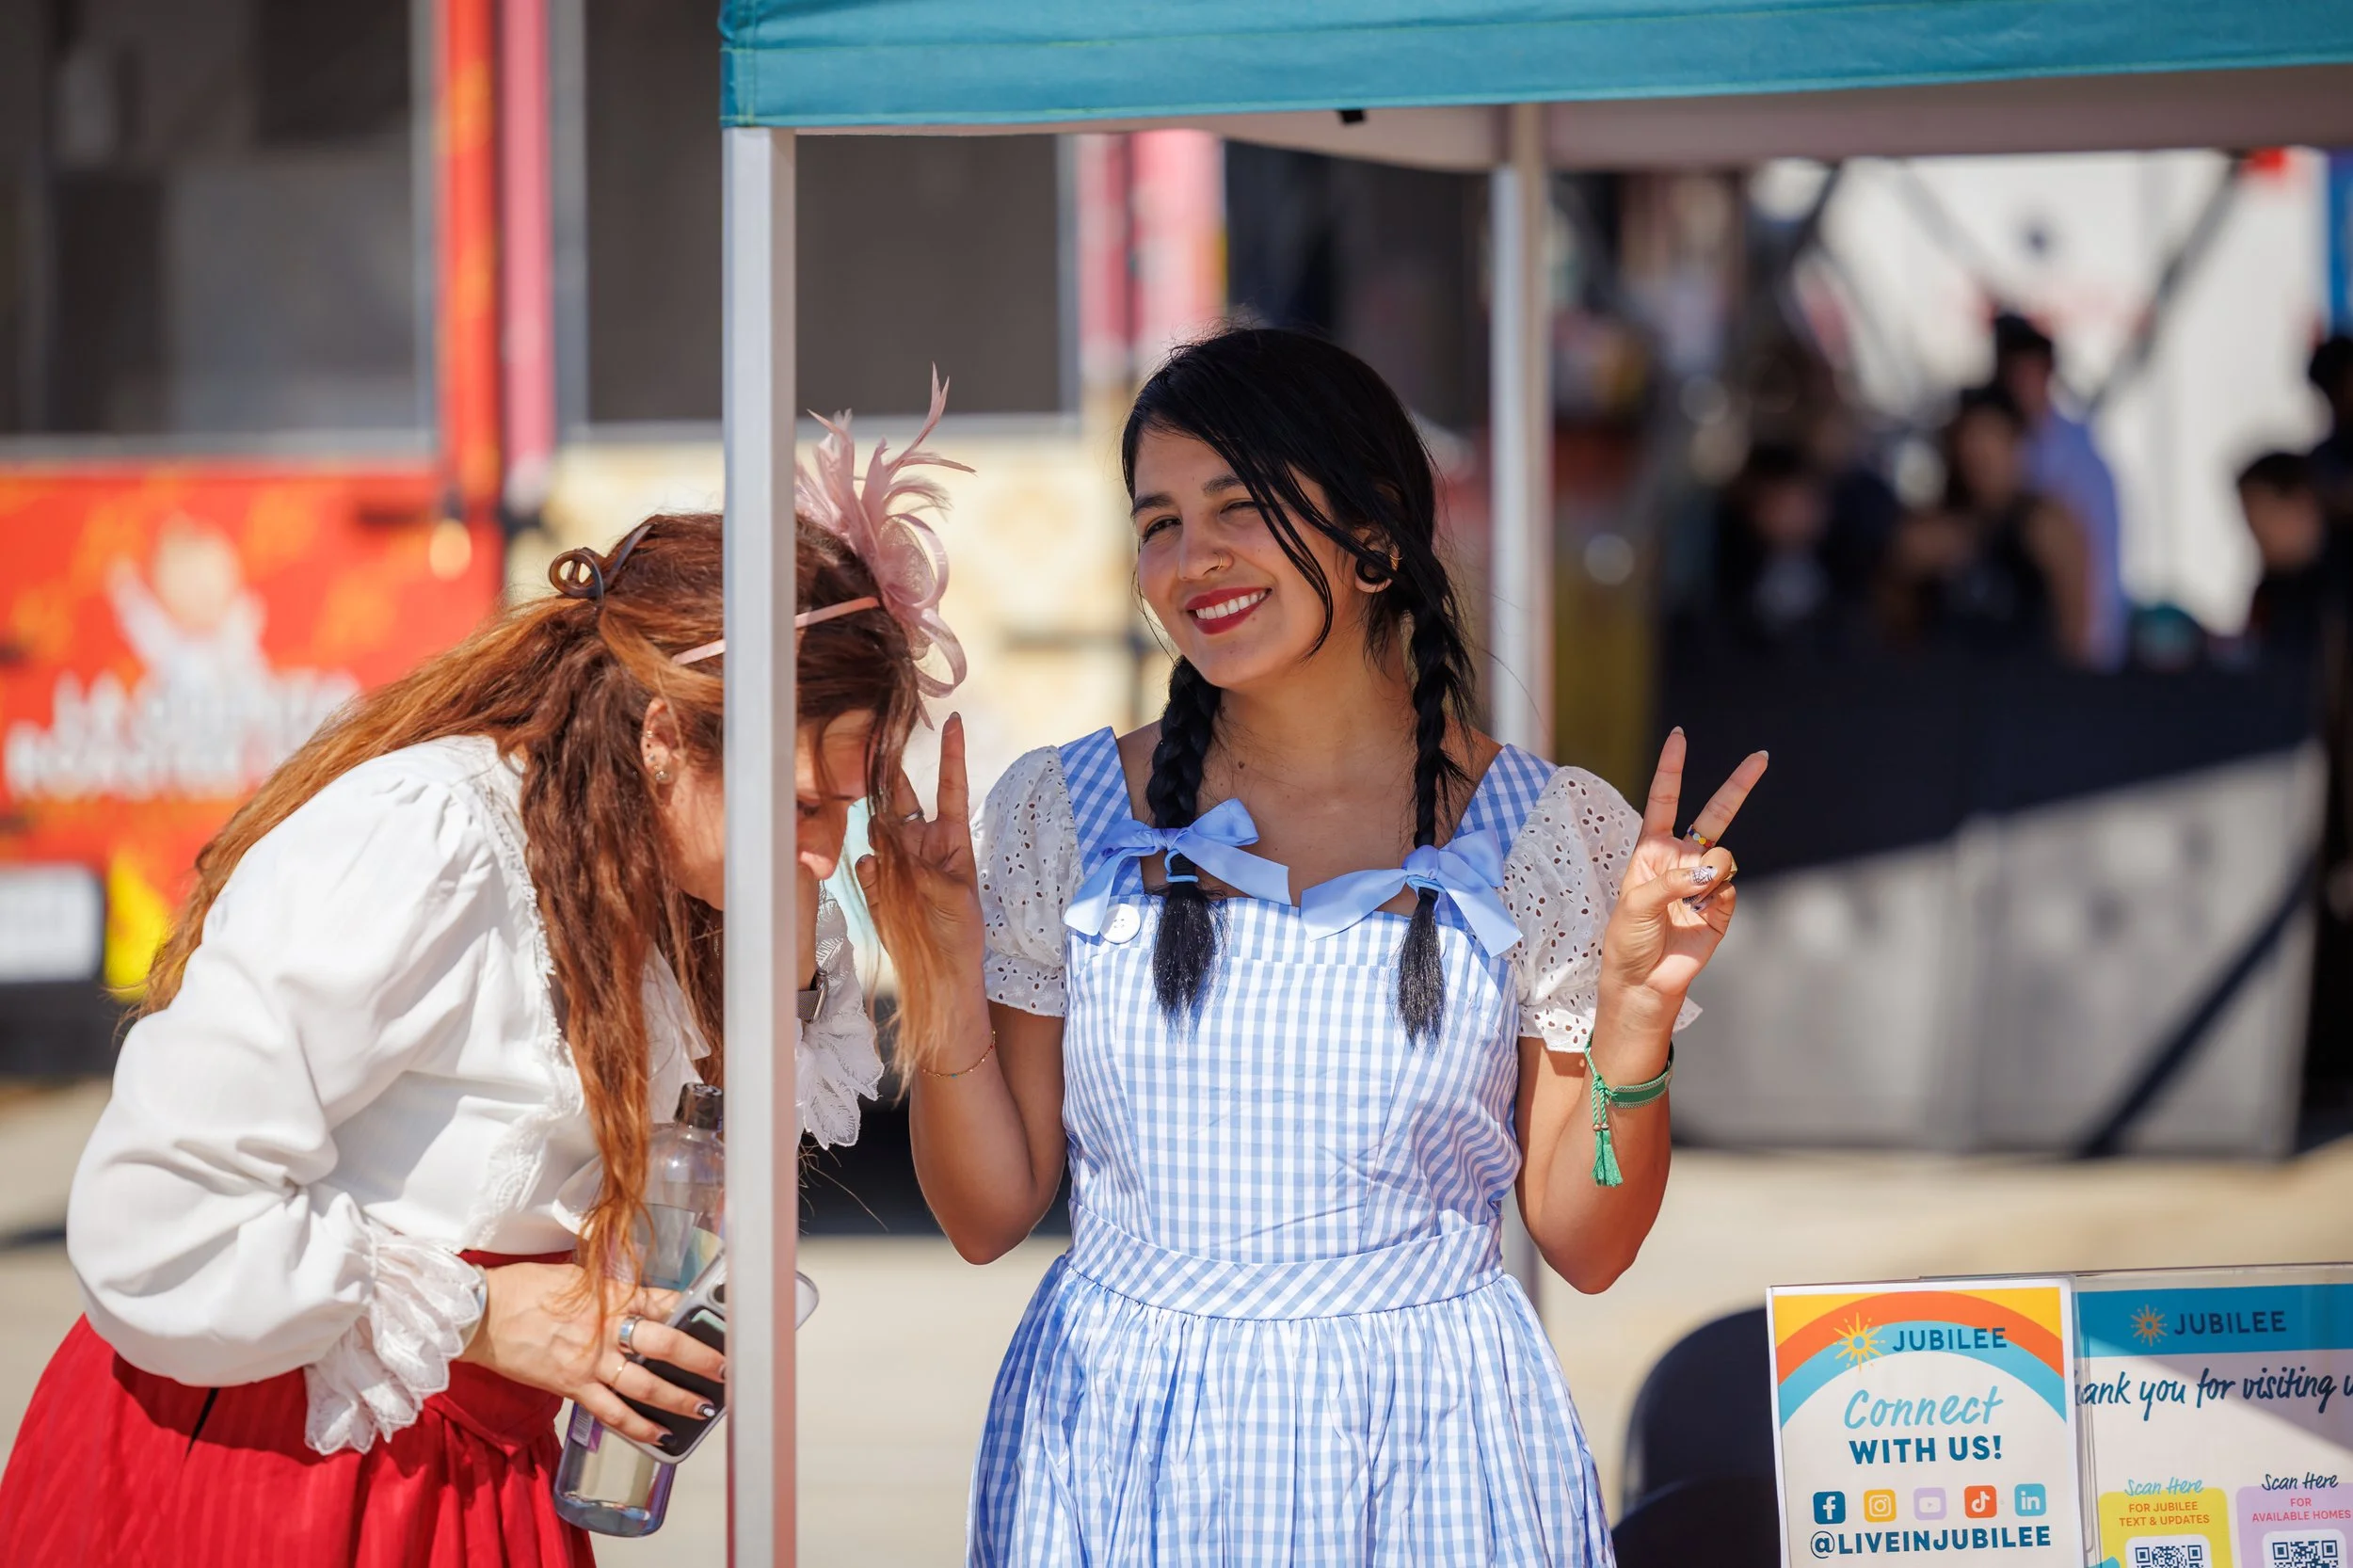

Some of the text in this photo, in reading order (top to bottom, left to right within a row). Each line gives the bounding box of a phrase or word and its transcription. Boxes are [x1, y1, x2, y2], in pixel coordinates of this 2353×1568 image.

[2173, 1310, 2287, 1336] JUBILEE
[1892, 1327, 2008, 1352] JUBILEE
[2073, 1369, 2131, 1406] ank
[2139, 1380, 2185, 1422] you
[2196, 1368, 2236, 1408] for
[2242, 1366, 2337, 1414] visiting
[1844, 1385, 2004, 1430] Connect
[1849, 1435, 2002, 1464] WITH US!
[2124, 1477, 2204, 1496] Scan Here
[2261, 1471, 2339, 1491] Scan Here
[2128, 1501, 2199, 1512] FOR JUBILEE
[2290, 1497, 2312, 1507] FOR
[2119, 1514, 2210, 1527] TEXT & UPDATES
[2251, 1510, 2351, 1523] AVAILABLE HOMES
[1810, 1526, 2052, 1559] @LIVEINJUBILEE
